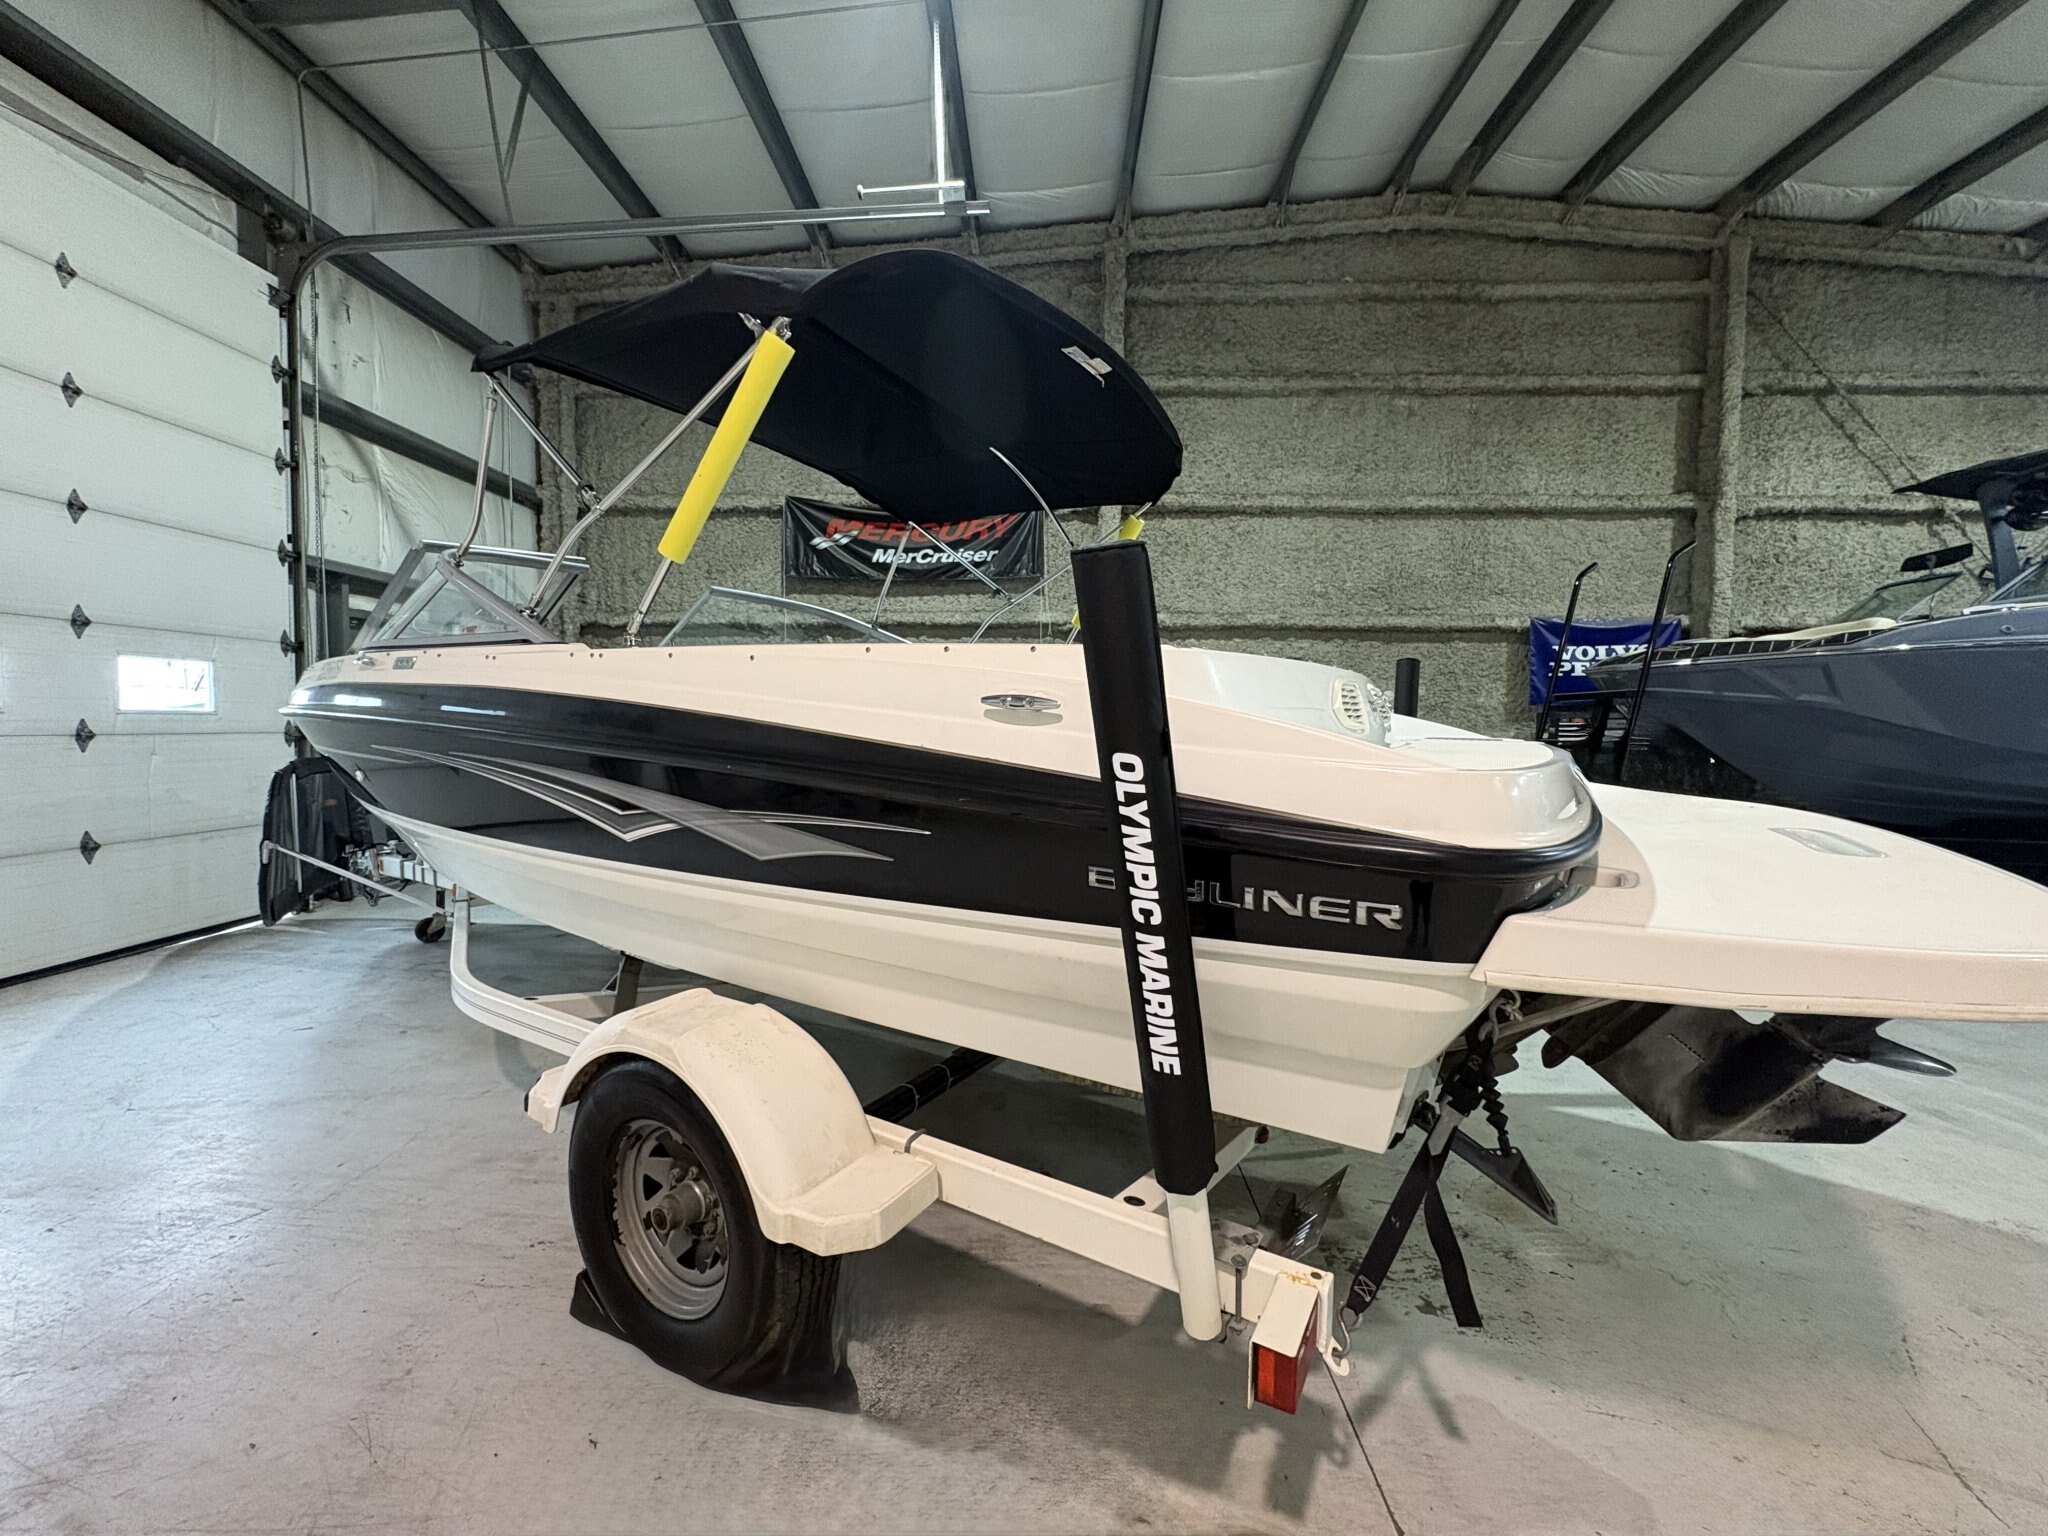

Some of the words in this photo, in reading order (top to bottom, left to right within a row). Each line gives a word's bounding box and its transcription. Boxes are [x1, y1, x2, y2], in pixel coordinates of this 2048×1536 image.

[825, 513, 1020, 542] MERCURY
[871, 548, 999, 564] MerCruiser
[1552, 643, 1649, 662] VOLV
[1112, 752, 1162, 926] OLYMPIC
[1135, 931, 1182, 1076] MARINE
